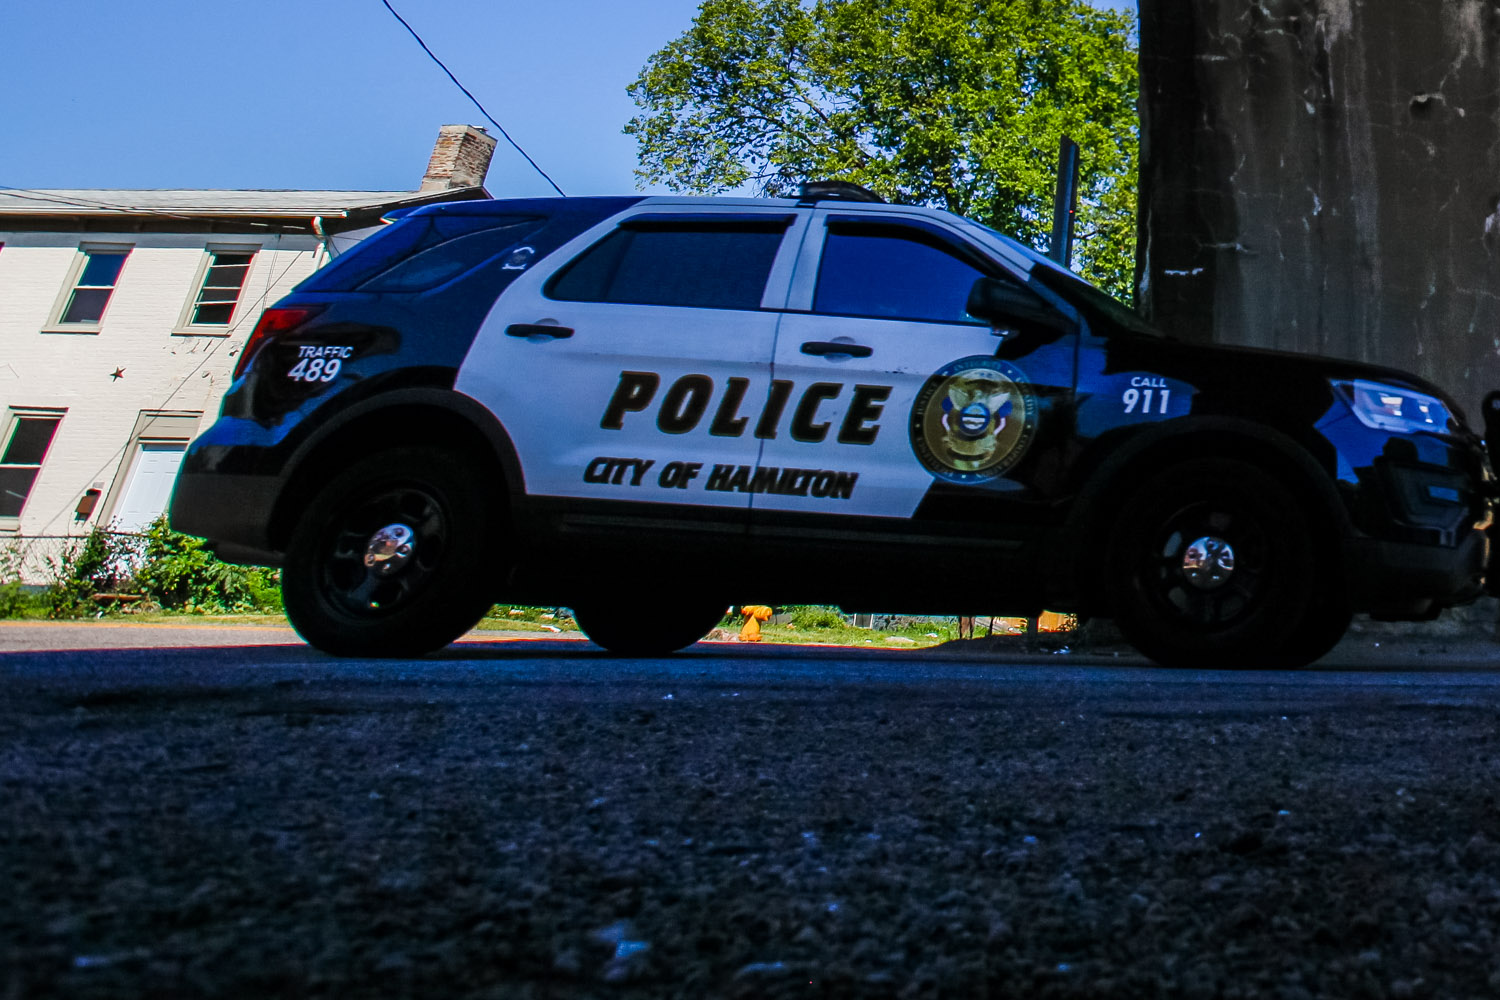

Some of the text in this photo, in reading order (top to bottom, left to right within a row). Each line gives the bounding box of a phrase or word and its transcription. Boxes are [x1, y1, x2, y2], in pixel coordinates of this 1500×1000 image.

[298, 346, 353, 358] TRAFFIC
[288, 358, 341, 382] 489
[1131, 377, 1167, 388] CALL
[599, 370, 894, 445] POLICE
[1123, 389, 1170, 414] 911
[584, 457, 858, 499] CITY OF HAMILTON
